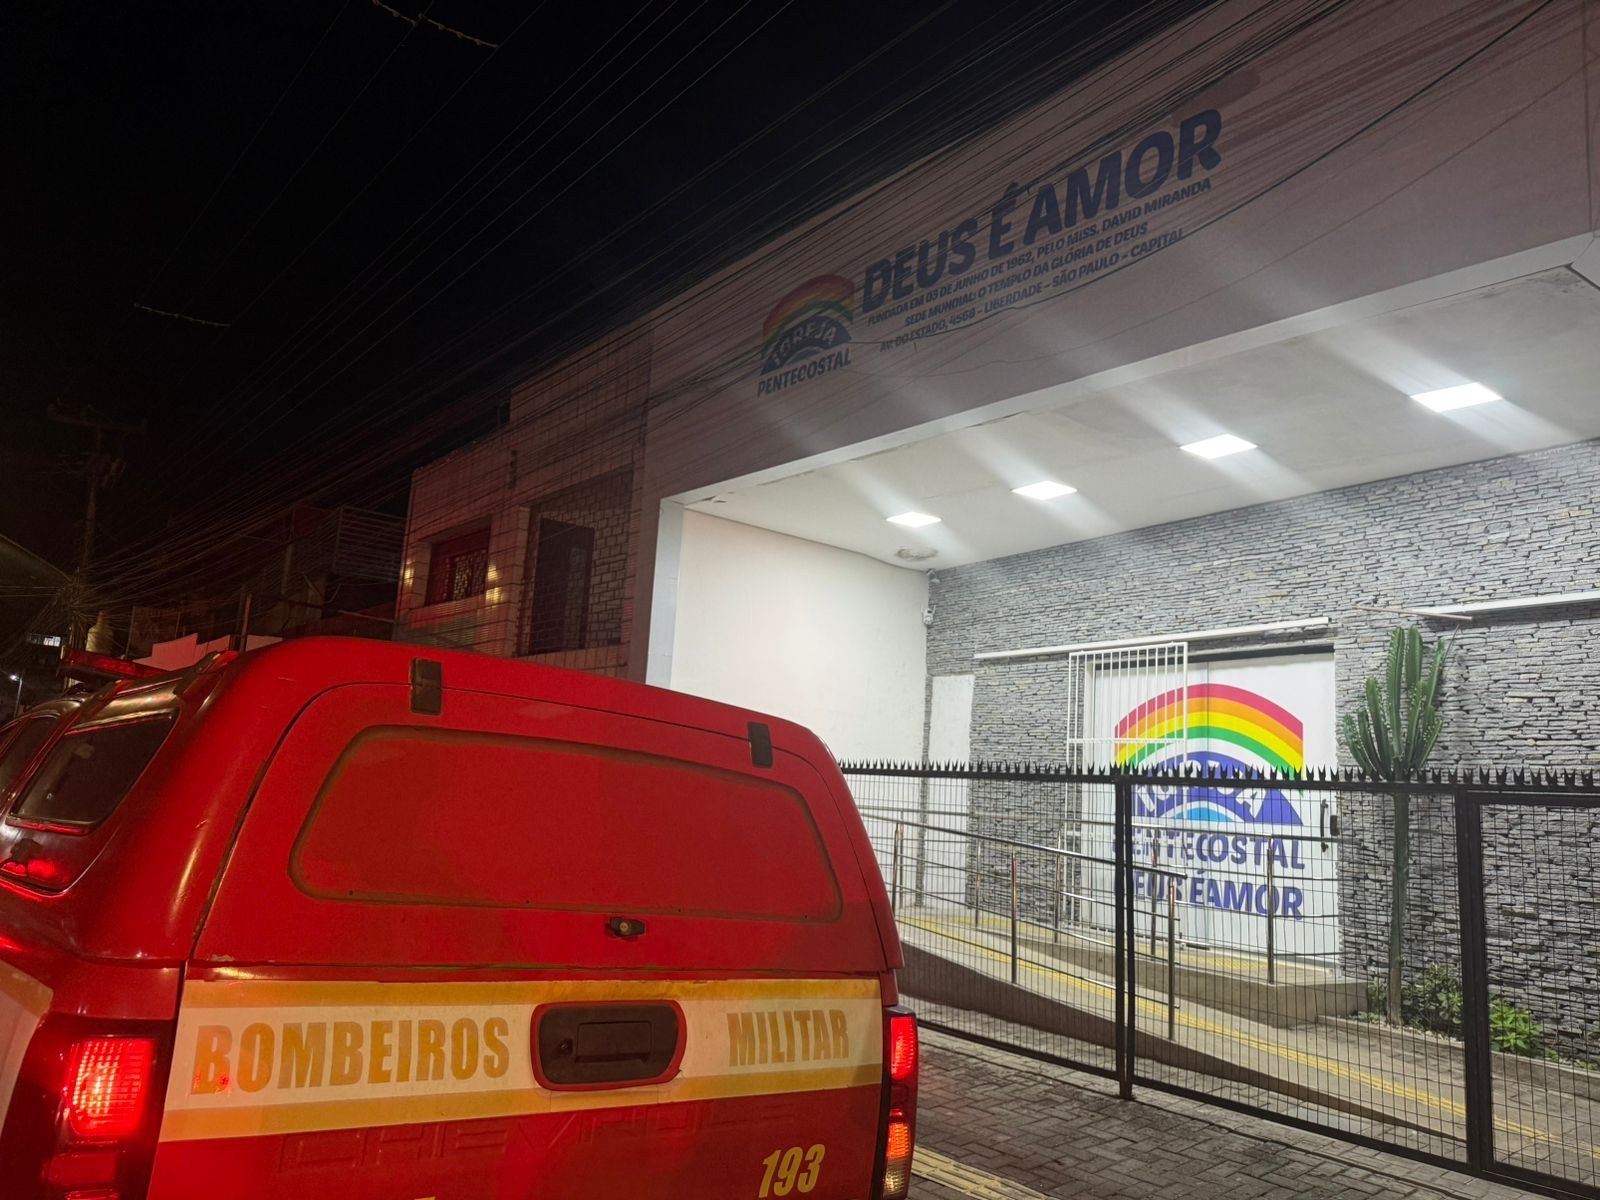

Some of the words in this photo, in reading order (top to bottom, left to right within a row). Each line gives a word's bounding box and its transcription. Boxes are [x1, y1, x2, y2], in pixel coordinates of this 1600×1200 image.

[861, 218, 978, 313] DEUS
[988, 181, 1019, 261] É
[1023, 108, 1223, 245] AMOR
[867, 302, 909, 327] FUNDADA
[909, 297, 925, 310] EM
[925, 291, 939, 307] 03
[939, 285, 953, 299] DE
[952, 269, 990, 294] JUNHO
[990, 262, 1004, 276] DE
[1037, 238, 1065, 258] PELO
[1067, 224, 1100, 247] MISS.
[1102, 206, 1142, 232] DAVID
[1144, 178, 1212, 215] MIRANDA
[895, 334, 909, 348] DO
[909, 317, 950, 341] ESTADO,
[984, 281, 1043, 312] LIBERDADE
[1052, 267, 1077, 288] SÃO
[1078, 252, 1120, 279] PAULO
[1130, 228, 1185, 257] CAPITAL
[904, 310, 928, 328] SEDE
[927, 292, 977, 318] MUNDIAL:
[977, 287, 988, 299] O
[988, 268, 1032, 294] TEMPLO
[1033, 263, 1050, 278] DA
[1051, 244, 1095, 270] GLÓRIA
[1095, 237, 1113, 252] DE
[1114, 221, 1148, 245] DEUS
[757, 348, 852, 398] PENTECOSTAL
[771, 321, 838, 366] IGREJA
[1113, 826, 1305, 870] ENTECOSTAL
[191, 1016, 511, 1095] BOMBEIROS
[727, 1008, 851, 1067] MILITAR
[758, 1143, 826, 1199] 193
